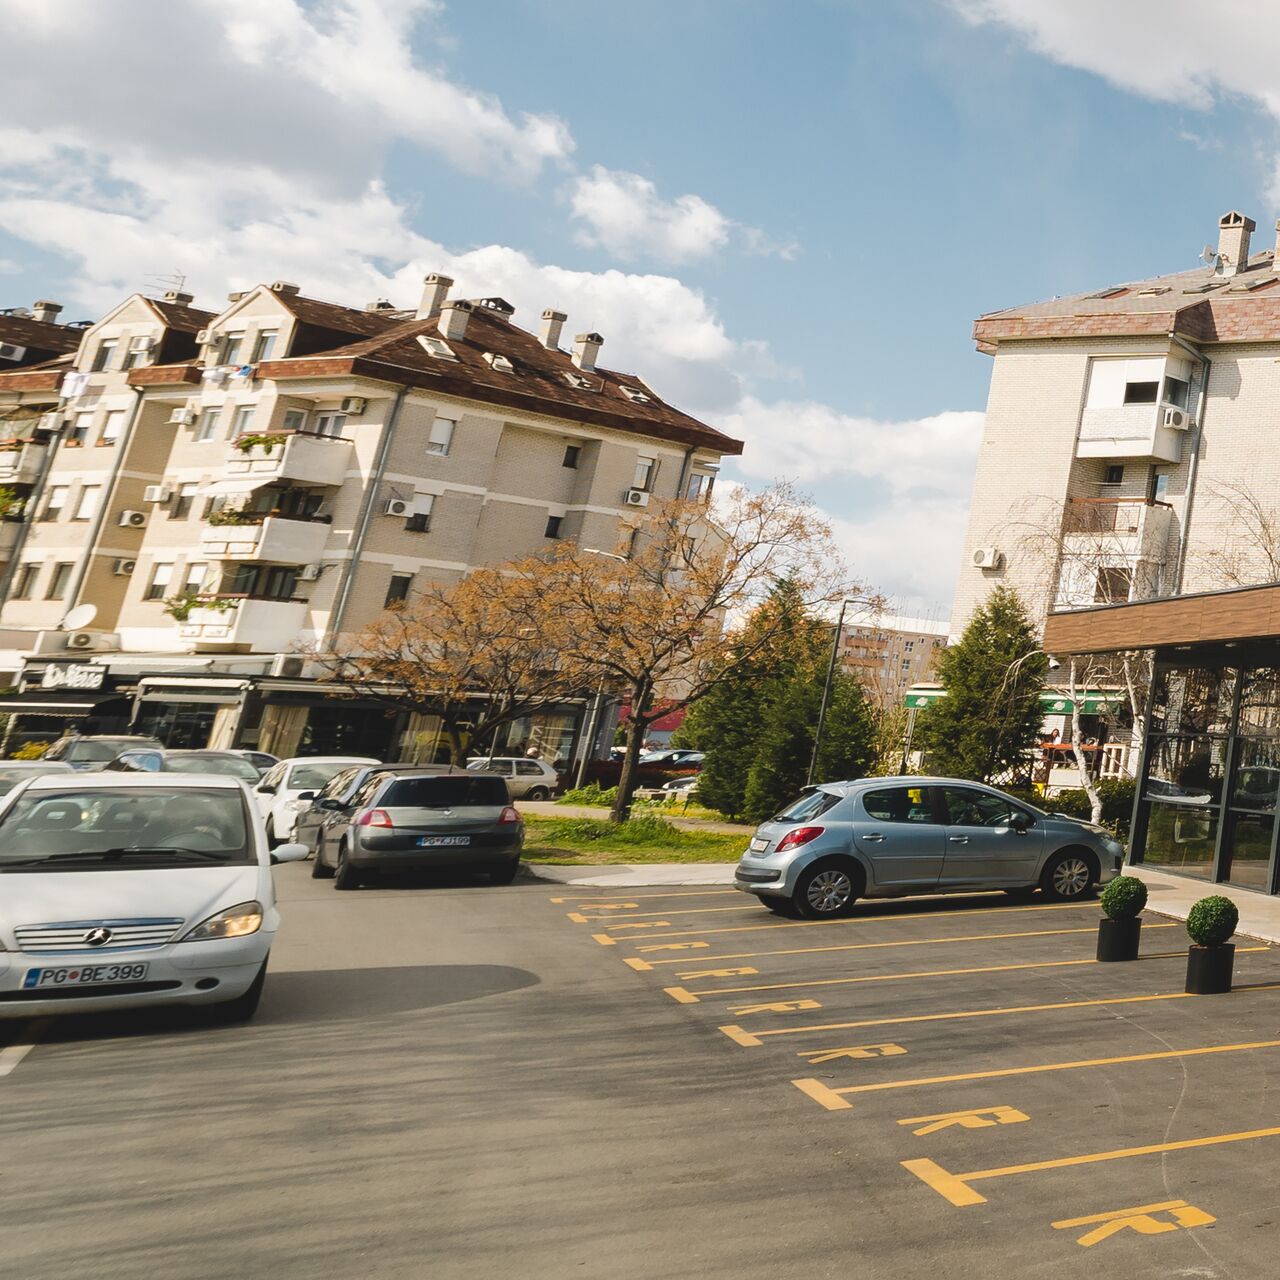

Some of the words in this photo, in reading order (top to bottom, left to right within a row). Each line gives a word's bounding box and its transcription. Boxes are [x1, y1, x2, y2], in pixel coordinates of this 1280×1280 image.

[40, 969, 67, 985] PG
[726, 999, 823, 1016] R
[797, 1043, 909, 1064] R
[896, 1105, 1031, 1136] R
[1051, 1199, 1217, 1247] R
